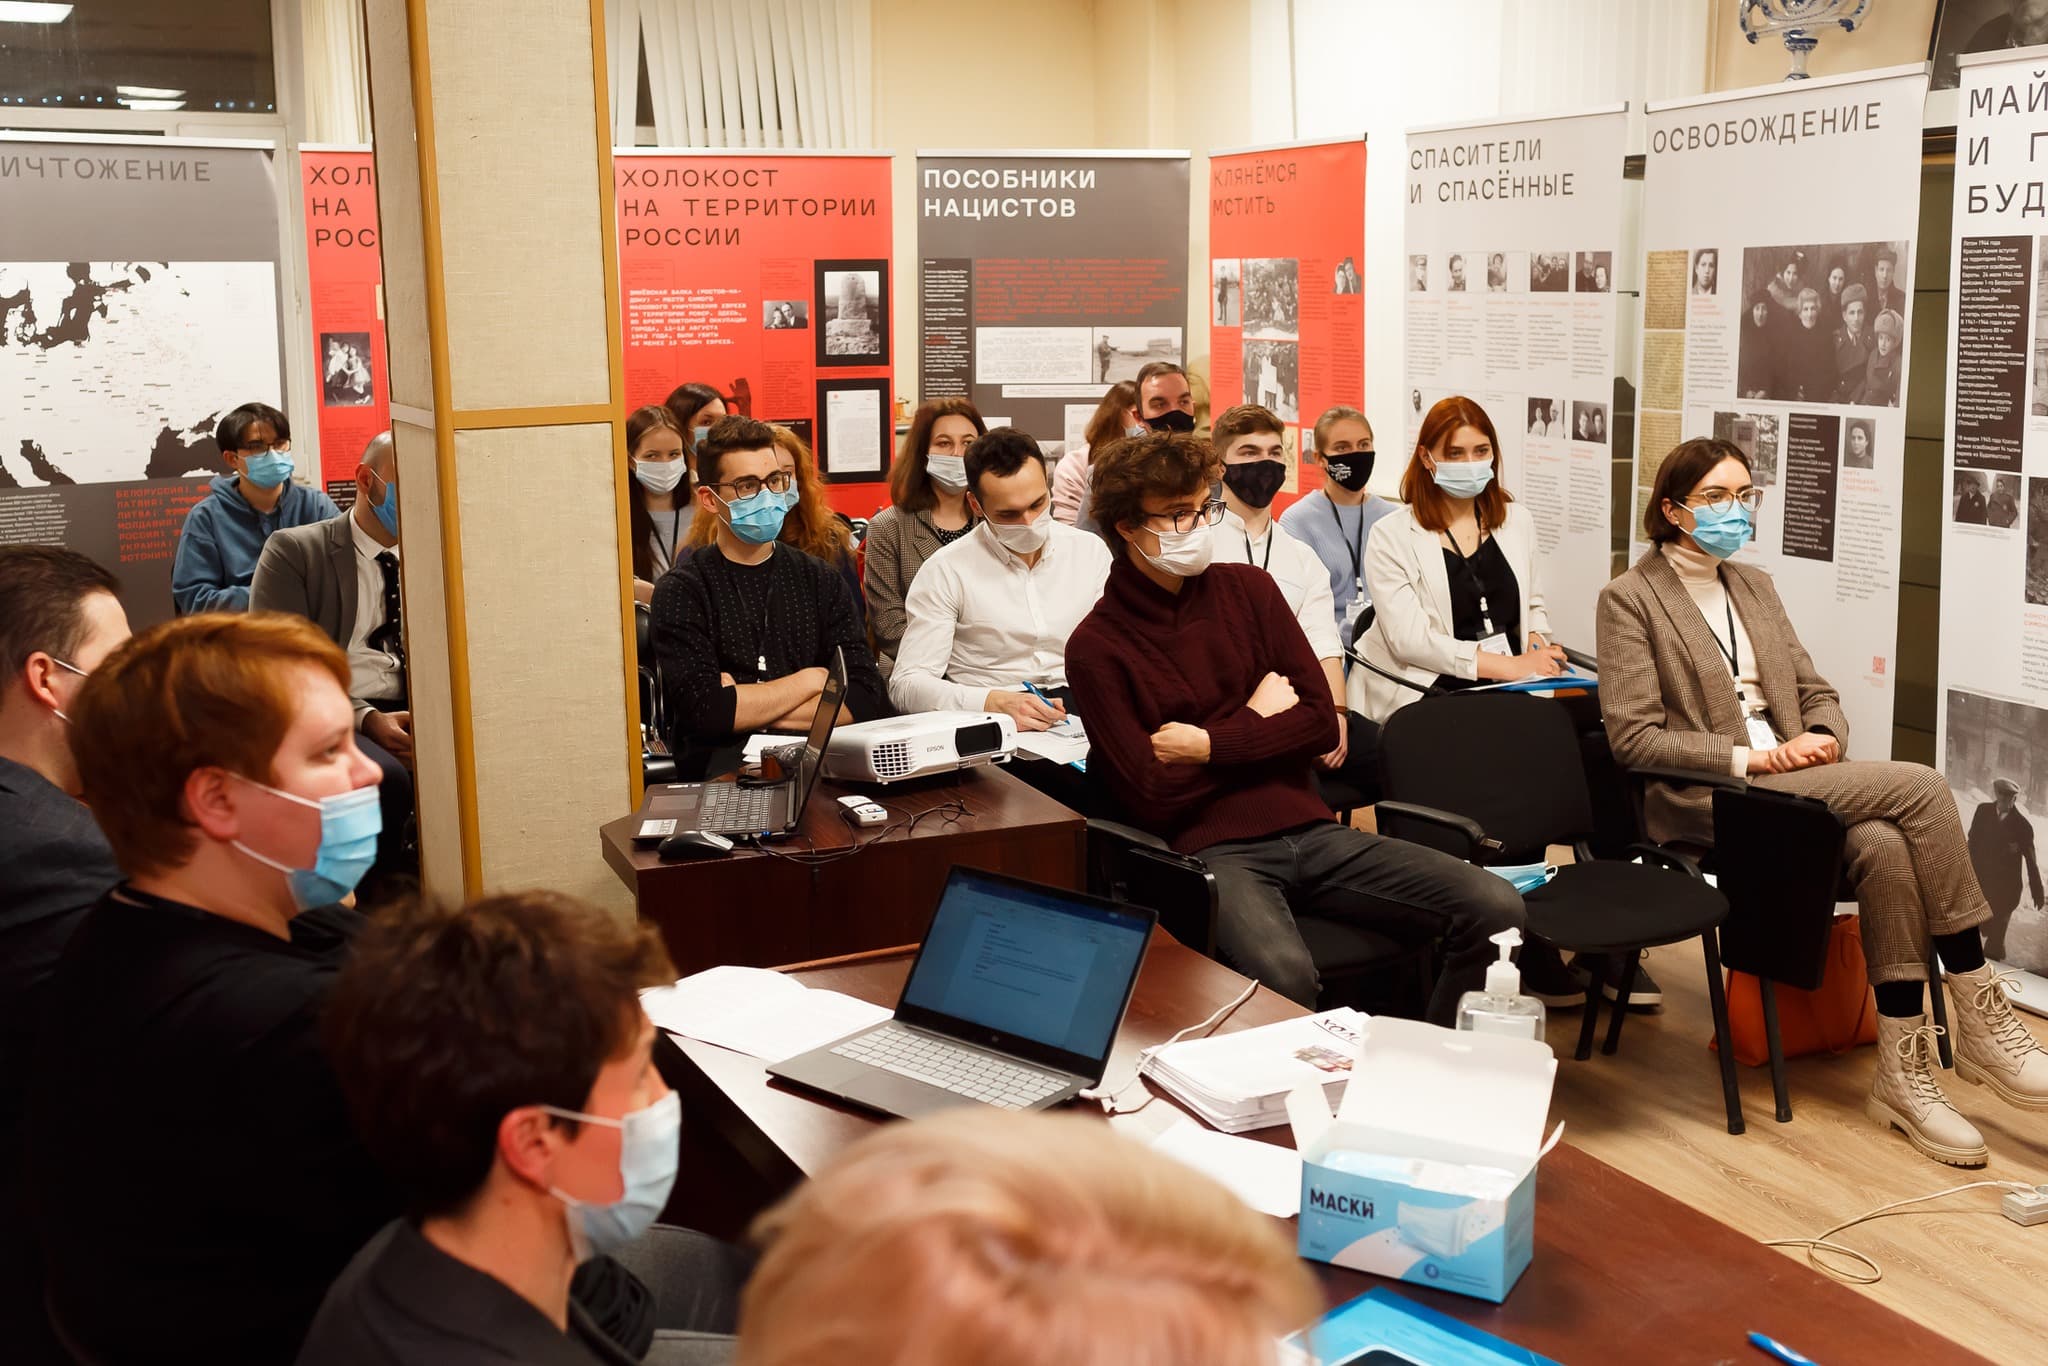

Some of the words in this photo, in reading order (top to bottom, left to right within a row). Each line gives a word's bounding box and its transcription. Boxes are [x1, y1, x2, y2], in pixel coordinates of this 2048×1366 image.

[1653, 102, 1881, 153] ОСВОБОЖДЕНИЕ
[1410, 138, 1542, 170] СПАСИТЕЛИ
[1968, 136, 1989, 166] И
[1, 156, 210, 181] ИЧТОЖЕНИЕ
[310, 166, 371, 185] ХОЛ
[622, 169, 778, 187] ХОЛОКОСТ
[924, 169, 1096, 189] ПОСОБНИКИ
[1214, 160, 1297, 188] КЛЯНЁМСЯ
[1410, 183, 1422, 204] И
[1438, 170, 1574, 202] СПАСЁННЫЕ
[312, 197, 351, 216] НА
[624, 200, 660, 217] НА
[683, 199, 876, 217] ТЕРРИТОРИИ
[924, 198, 1077, 221] НАЦИСТОВ
[1213, 196, 1275, 217] МСТИТЬ
[1968, 182, 2046, 218] БУД
[315, 229, 375, 247] РОС
[626, 228, 740, 246] РОССИИ
[926, 744, 945, 753] EPSON
[1310, 1187, 1375, 1220] МАСКИ
